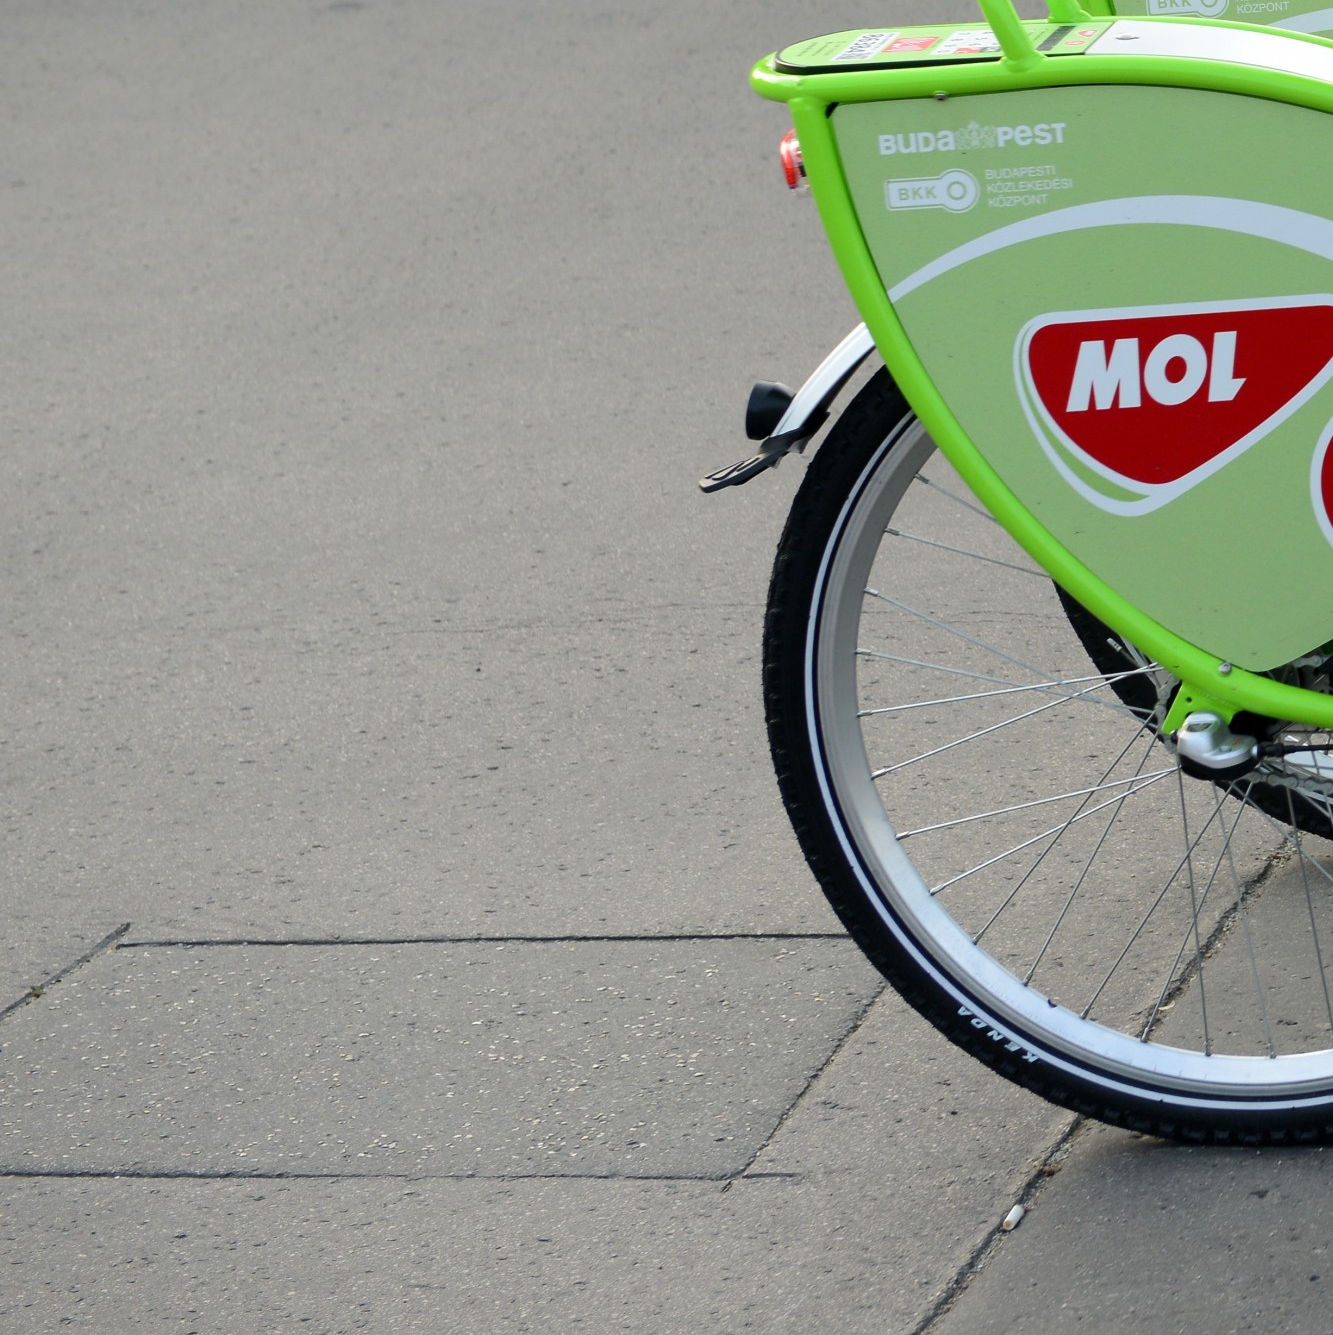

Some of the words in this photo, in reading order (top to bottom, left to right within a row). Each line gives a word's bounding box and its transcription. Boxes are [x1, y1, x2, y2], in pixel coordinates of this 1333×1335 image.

[1236, 1, 1290, 15] KÖZPONT
[985, 166, 1057, 180] BUDAPESTI
[897, 185, 938, 201] BKK
[1066, 330, 1247, 413] MOL
[957, 1005, 1040, 1063] KENDA
